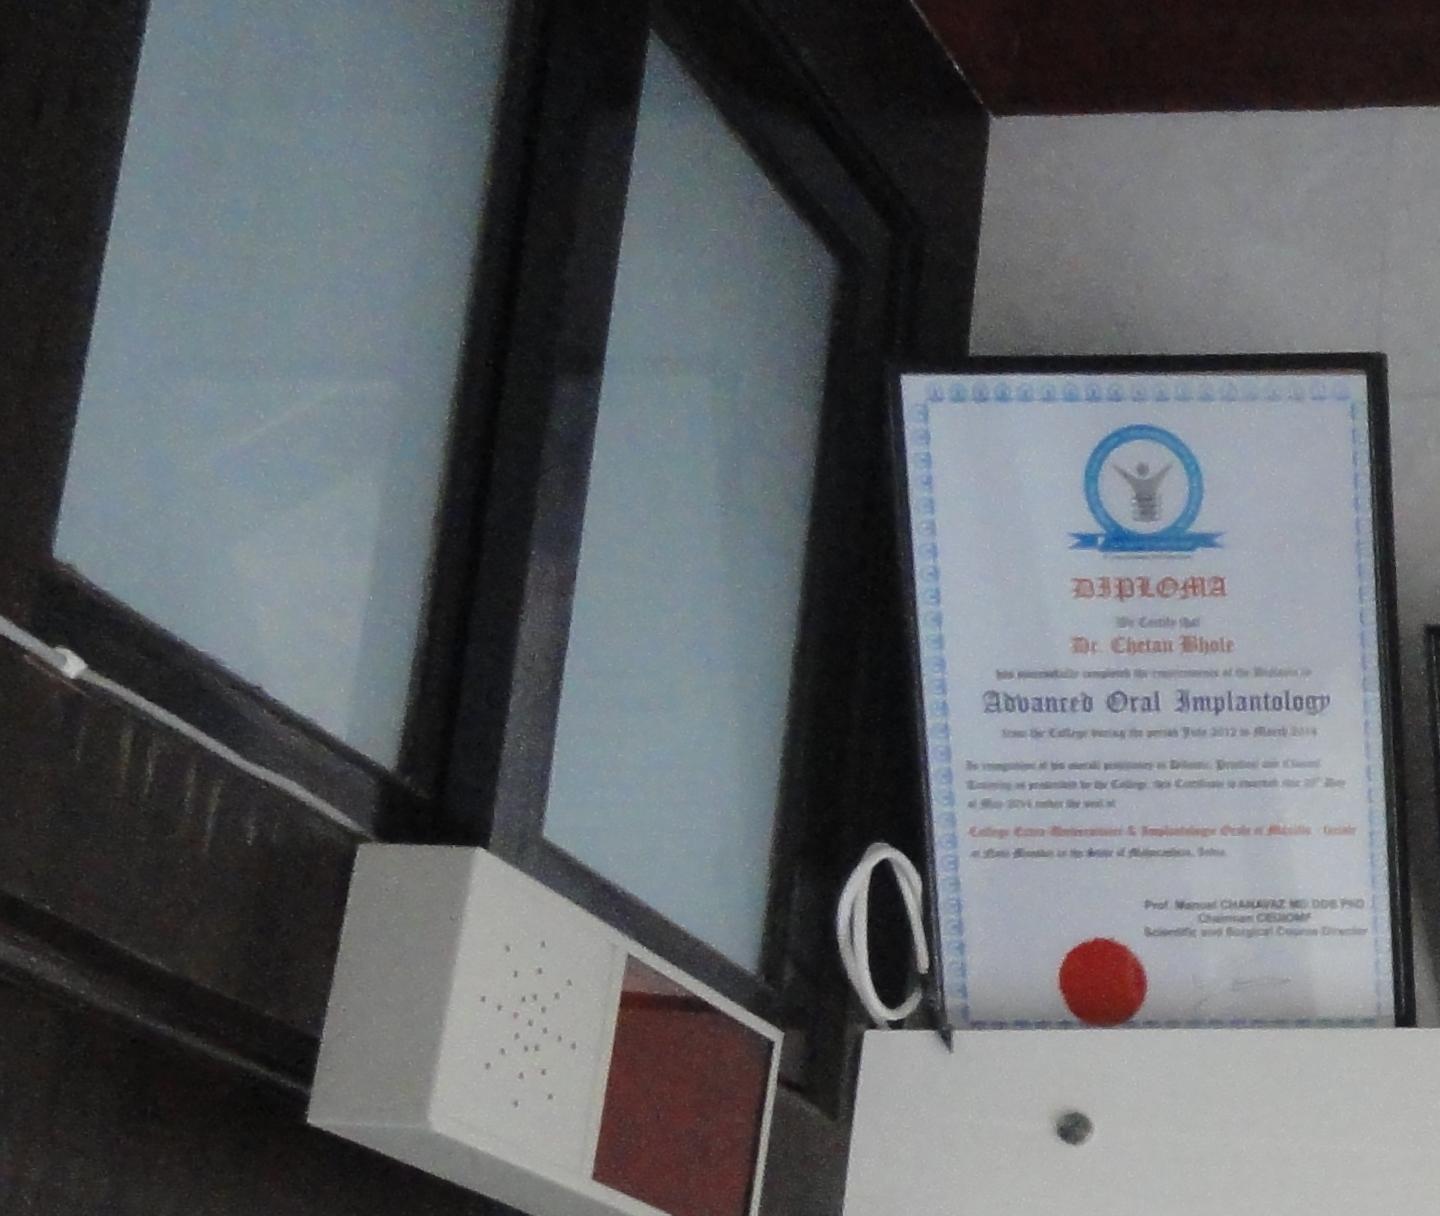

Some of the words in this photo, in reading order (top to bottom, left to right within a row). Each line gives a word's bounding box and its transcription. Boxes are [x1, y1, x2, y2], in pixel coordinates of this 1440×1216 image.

[1070, 575, 1229, 601] DIPLOMA
[1110, 636, 1174, 655] Chetan
[1180, 635, 1235, 656] Bhole
[982, 689, 1093, 714] Advanced
[1106, 689, 1161, 713] Oral
[1174, 688, 1331, 717] Implantology
